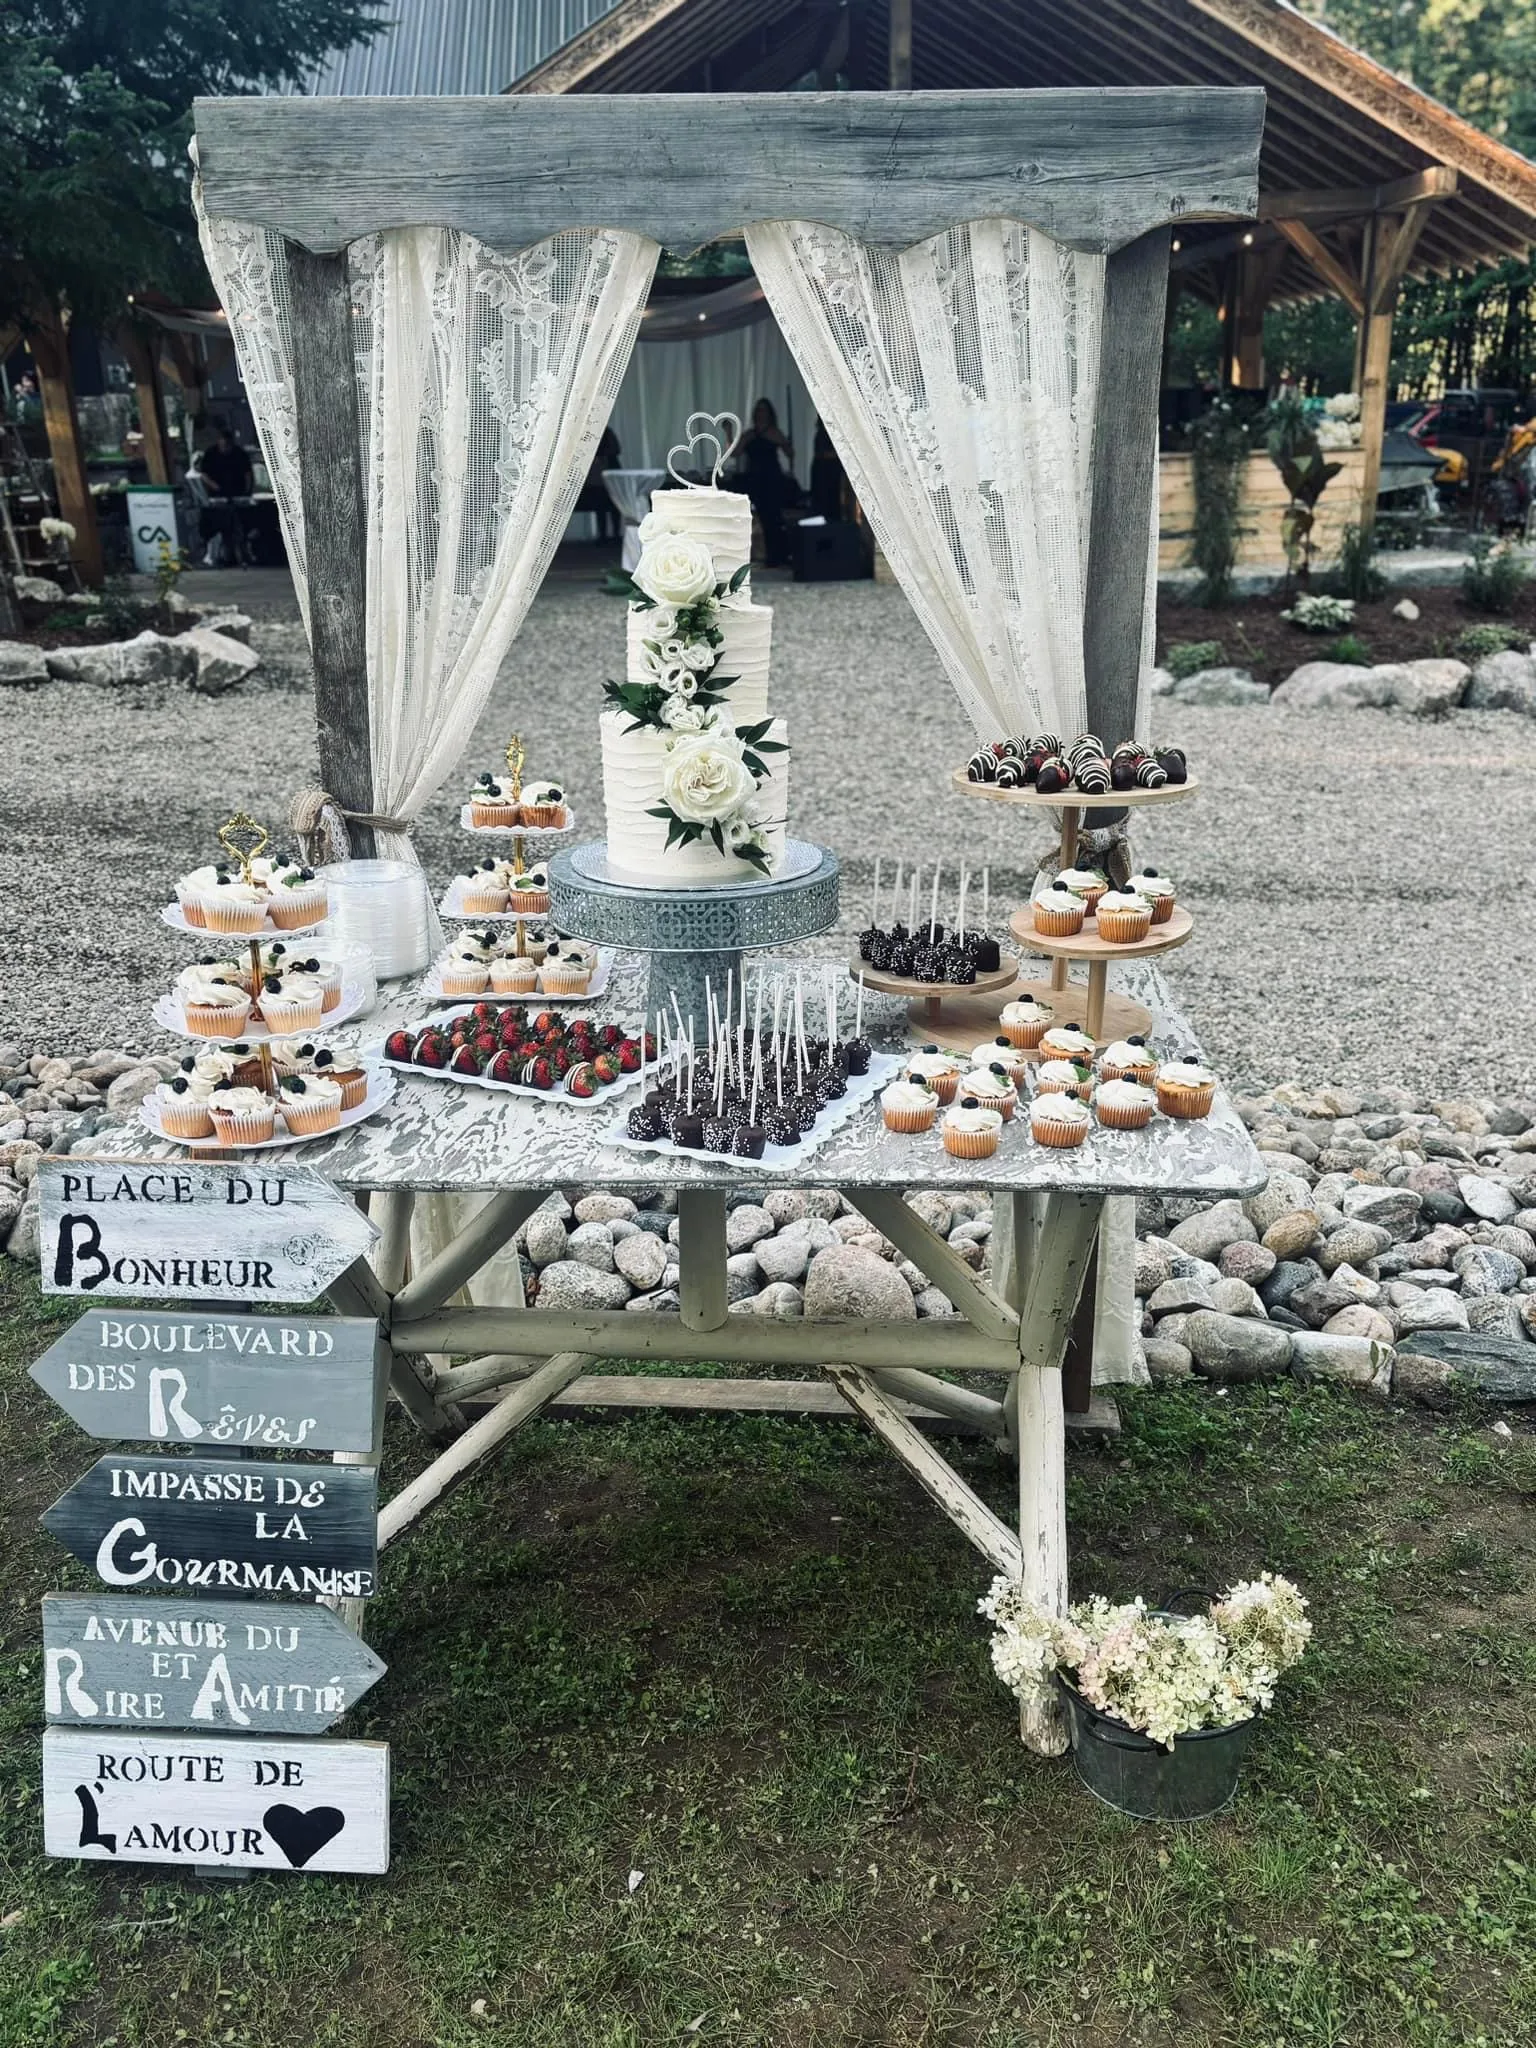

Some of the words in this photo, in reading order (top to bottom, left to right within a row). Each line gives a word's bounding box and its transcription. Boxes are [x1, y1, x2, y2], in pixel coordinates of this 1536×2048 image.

[61, 1174, 194, 1203] PLACE
[226, 1178, 286, 1206] DU
[54, 1213, 277, 1290] BONHEUR
[99, 1320, 334, 1357] BOULEVARD
[68, 1364, 136, 1391] DES
[109, 1469, 265, 1501] IMPASSE
[275, 1477, 326, 1508] DE
[255, 1512, 309, 1541] LA
[83, 1615, 227, 1649] AVENUE
[245, 1624, 300, 1652] DU
[152, 1652, 196, 1680] ET
[46, 1647, 165, 1718] RIRE
[190, 1652, 345, 1726] AMITIÉ
[96, 1754, 225, 1782] ROUTE
[254, 1760, 304, 1787] DE
